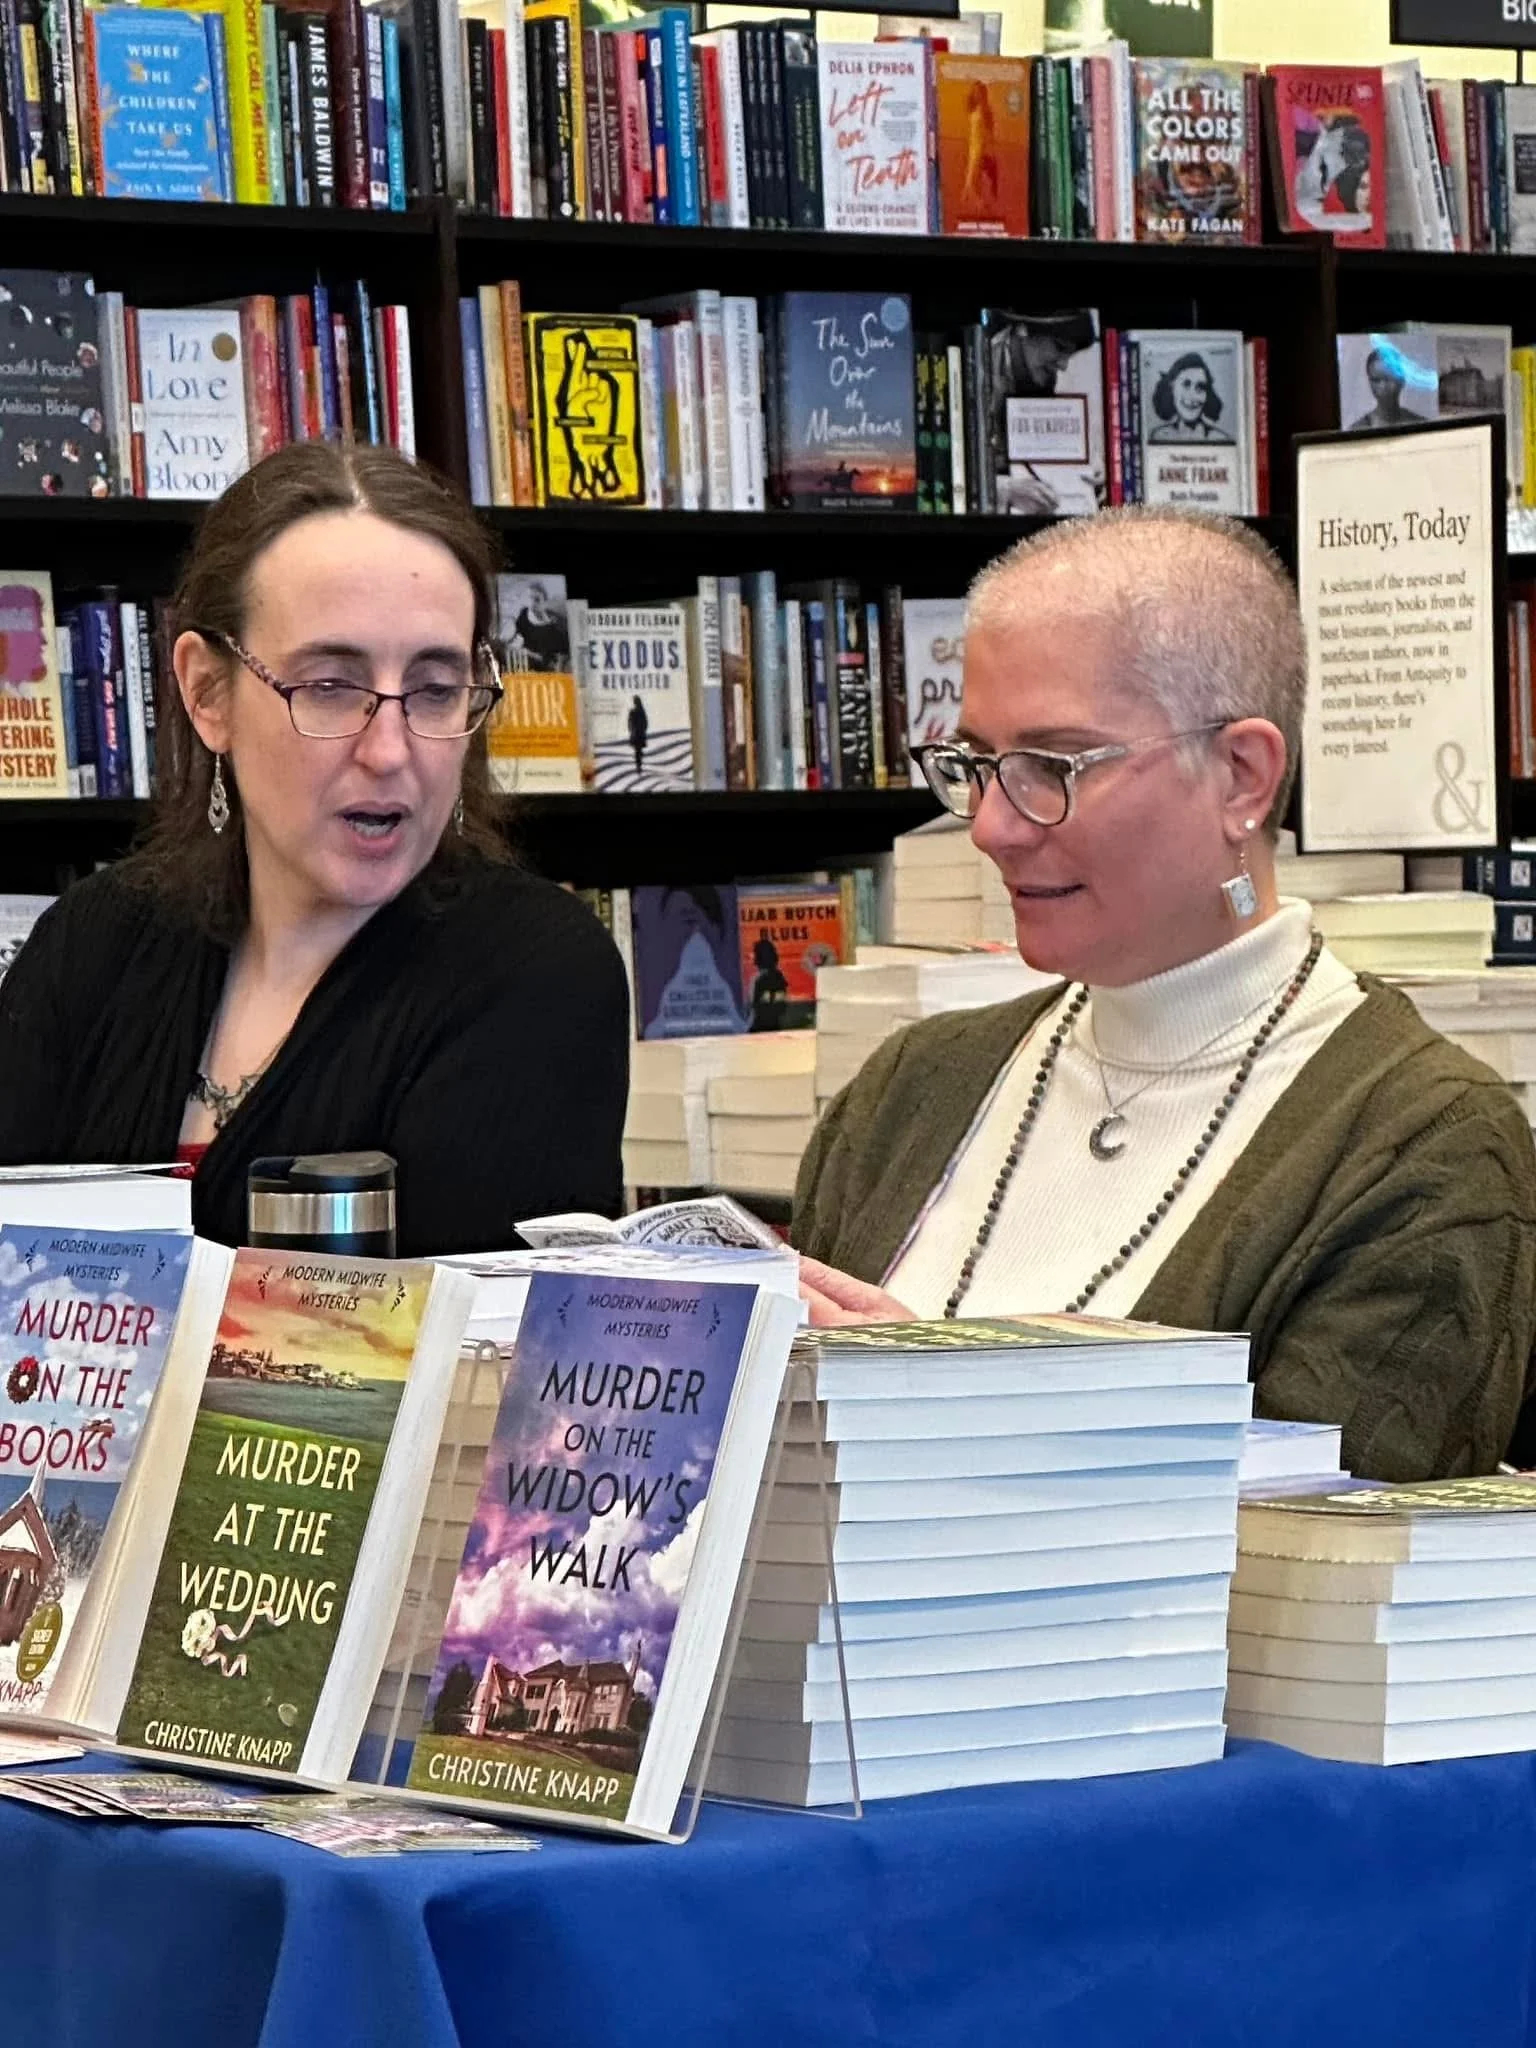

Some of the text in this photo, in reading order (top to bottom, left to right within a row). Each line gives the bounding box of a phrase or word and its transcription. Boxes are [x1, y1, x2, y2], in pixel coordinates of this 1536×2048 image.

[127, 45, 180, 60] WHERE
[673, 20, 686, 73] EINSTEIN
[143, 71, 171, 84] THE
[829, 61, 864, 75] DELIA
[118, 95, 197, 111] CHILDREN
[308, 25, 334, 188] JAMES BALDWIN
[828, 81, 894, 128] Left
[1148, 89, 1242, 111] ALL THE
[127, 122, 192, 137] TAKE US
[836, 124, 866, 151] on
[1147, 115, 1243, 139] COLORS
[1146, 144, 1243, 164] CAME OUT
[846, 149, 919, 199] Tenth
[1147, 217, 1243, 233] KATE FAGAN
[169, 334, 201, 363] In
[812, 312, 895, 358] The Sun
[147, 370, 228, 400] Love
[829, 356, 876, 387] Over
[806, 407, 902, 445] Mountains
[155, 429, 228, 461] Amy
[1319, 508, 1470, 551] History, Today
[1388, 573, 1404, 589] the
[1446, 569, 1466, 585] and
[1395, 595, 1427, 611] books
[1458, 592, 1475, 608] the
[139, 632, 151, 668] BLOOD
[589, 639, 679, 670] EXODUS
[142, 671, 153, 702] RUNS
[602, 673, 671, 689] REVISITED
[0, 755, 57, 779] STERY
[1432, 741, 1490, 835] &
[785, 904, 836, 921] BUTCH
[760, 927, 809, 941] BLUES
[50, 1239, 146, 1258] MODERN MIDWIFE
[63, 1265, 122, 1281] MYSTERIES
[283, 1266, 387, 1288] MODERN MIDWIFE
[298, 1292, 360, 1312] MYSTERIES
[586, 1293, 701, 1315] MODERN MIDWIFE
[14, 1299, 155, 1347] MURDER
[603, 1321, 672, 1339] MYSTERIES
[76, 1366, 133, 1409] THE
[540, 1360, 705, 1416] MURDER
[0, 1423, 112, 1473] BOOKS
[563, 1423, 656, 1459] ON THE
[216, 1433, 361, 1491] MURDER
[507, 1462, 692, 1525] WIDOW'S
[213, 1502, 332, 1556] AT THE
[530, 1535, 641, 1592] WALK
[179, 1562, 337, 1625] WEDDING
[144, 1720, 292, 1766] CHRISTINE KNAPP
[428, 1752, 620, 1806] CHRISTINE KNAPP
